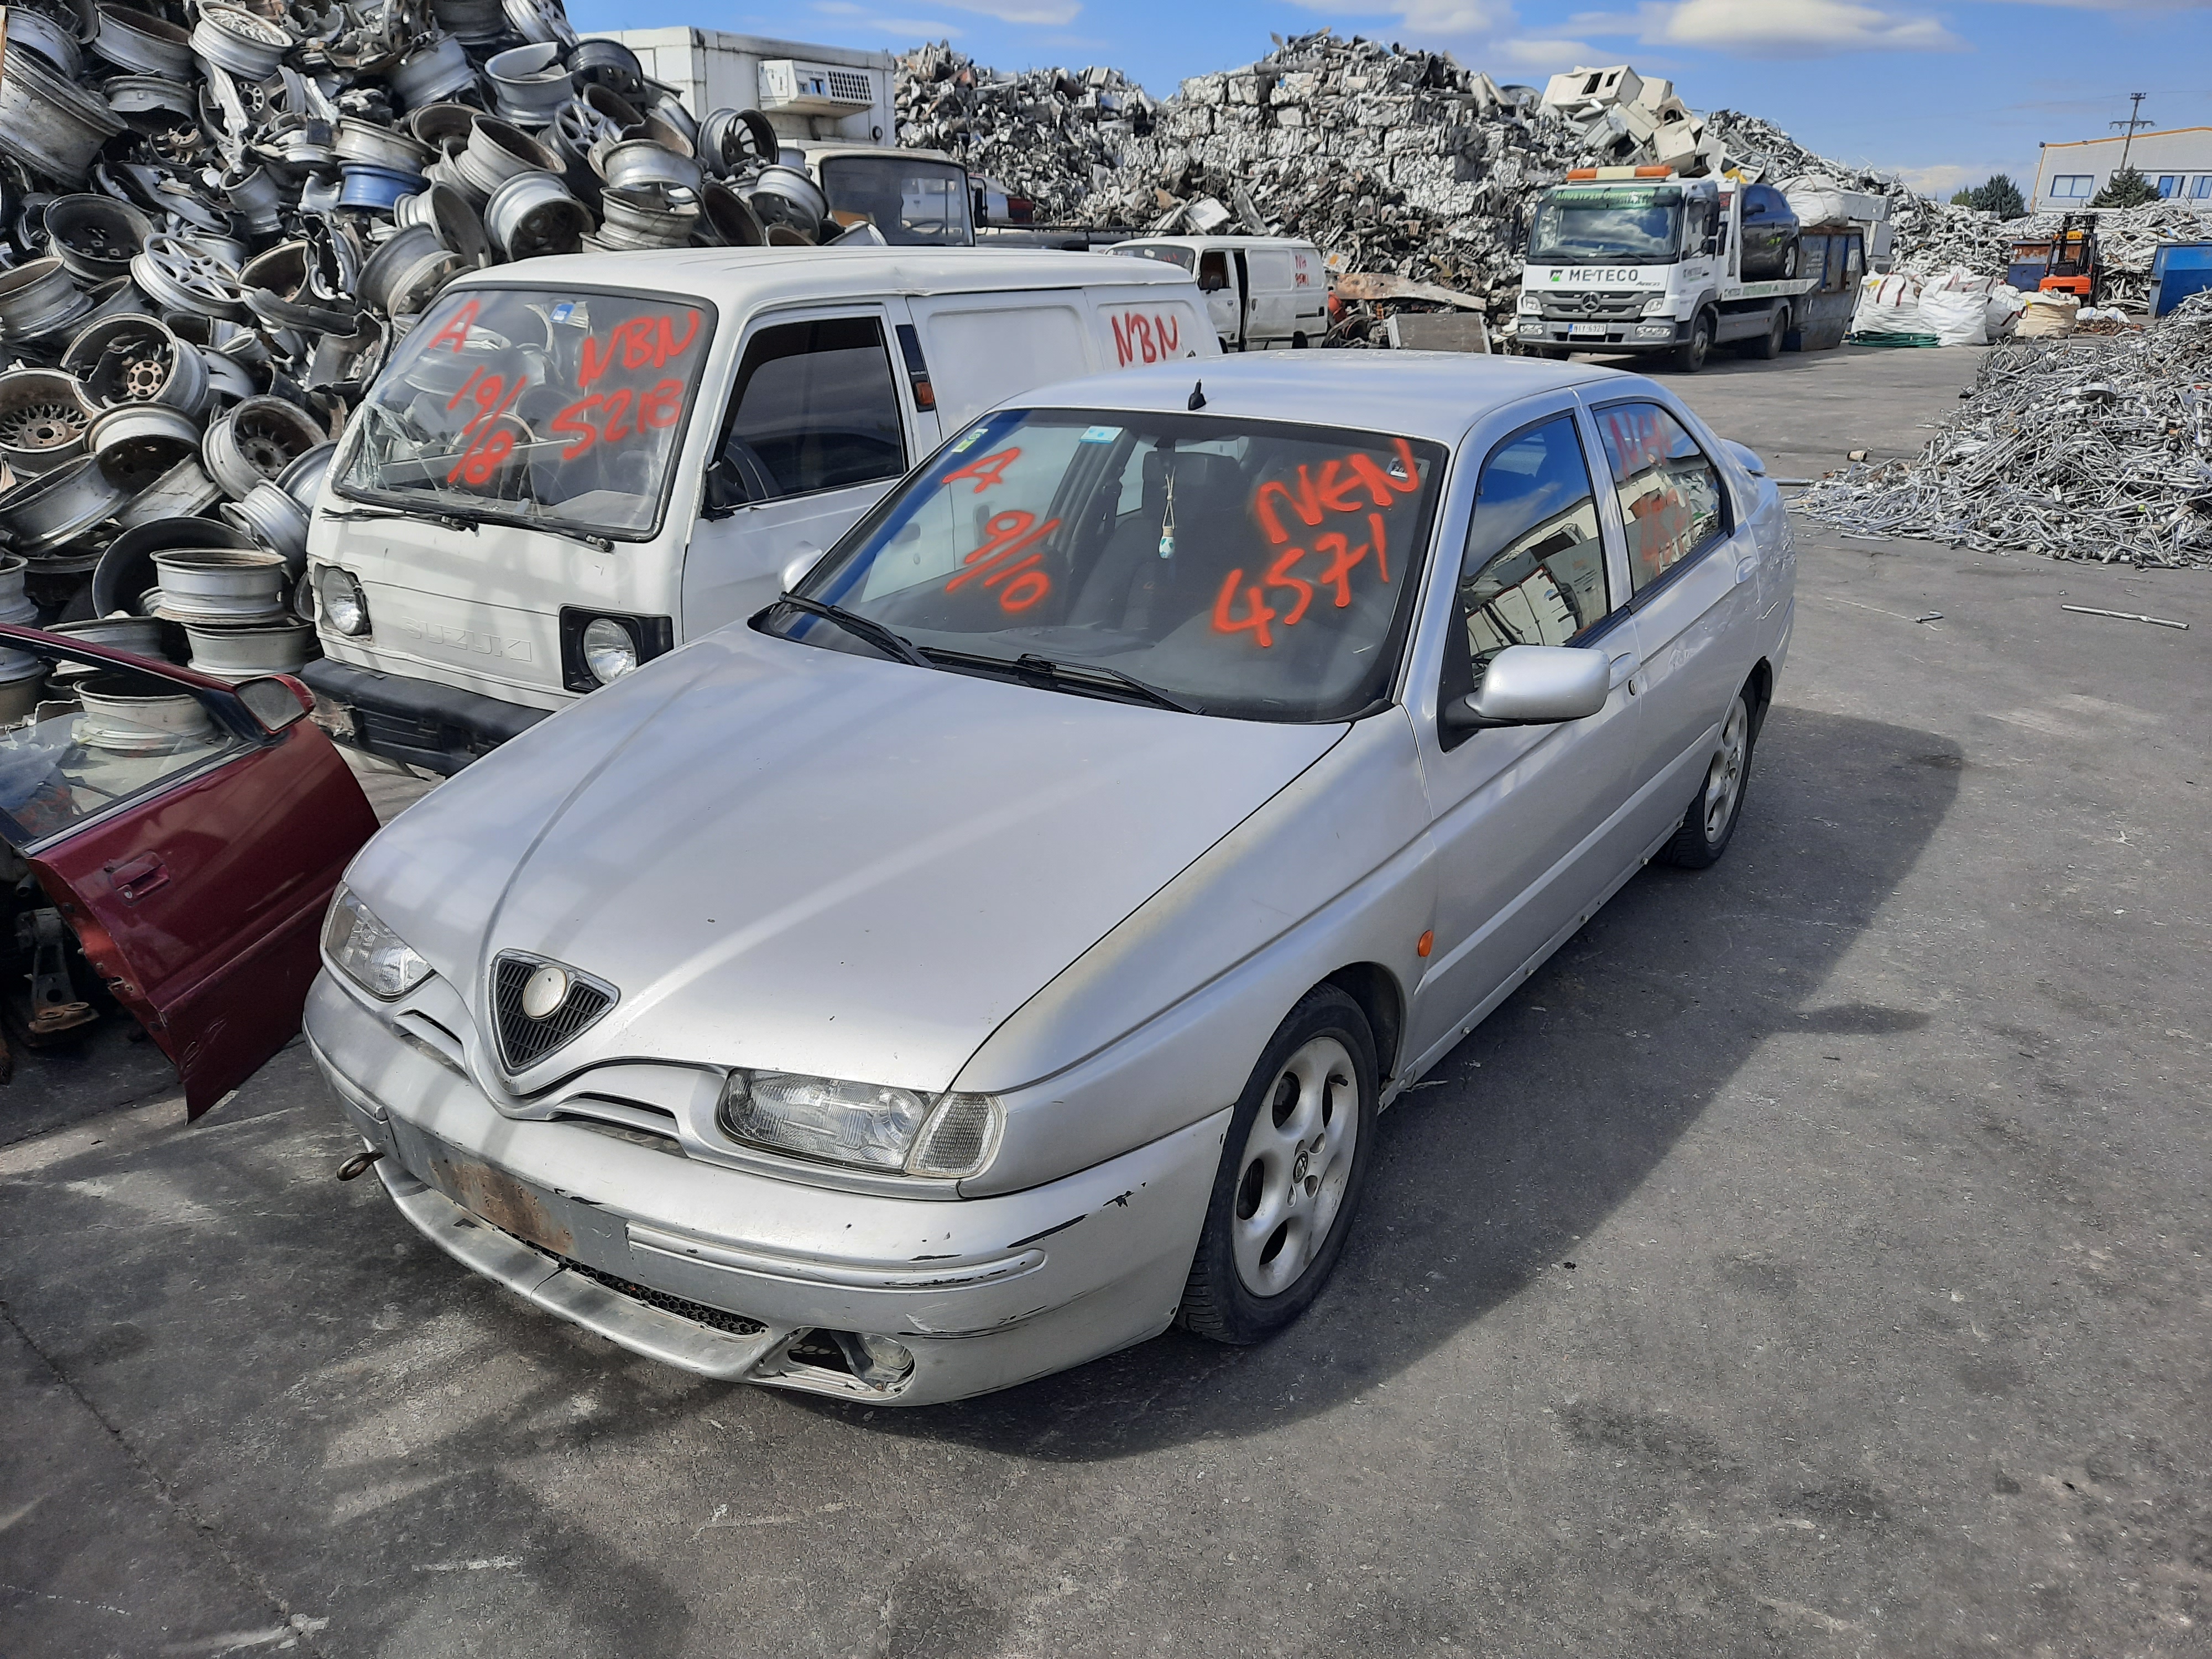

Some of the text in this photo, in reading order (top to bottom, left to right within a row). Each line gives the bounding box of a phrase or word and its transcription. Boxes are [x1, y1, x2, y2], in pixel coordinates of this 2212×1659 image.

[1569, 269, 1639, 281] METECO
[428, 299, 480, 353] A
[578, 310, 700, 387] NBN
[1110, 311, 1178, 368] NBN
[942, 447, 1021, 494] A
[1211, 513, 1390, 647] 4571
[401, 616, 532, 662] SUZUKI
